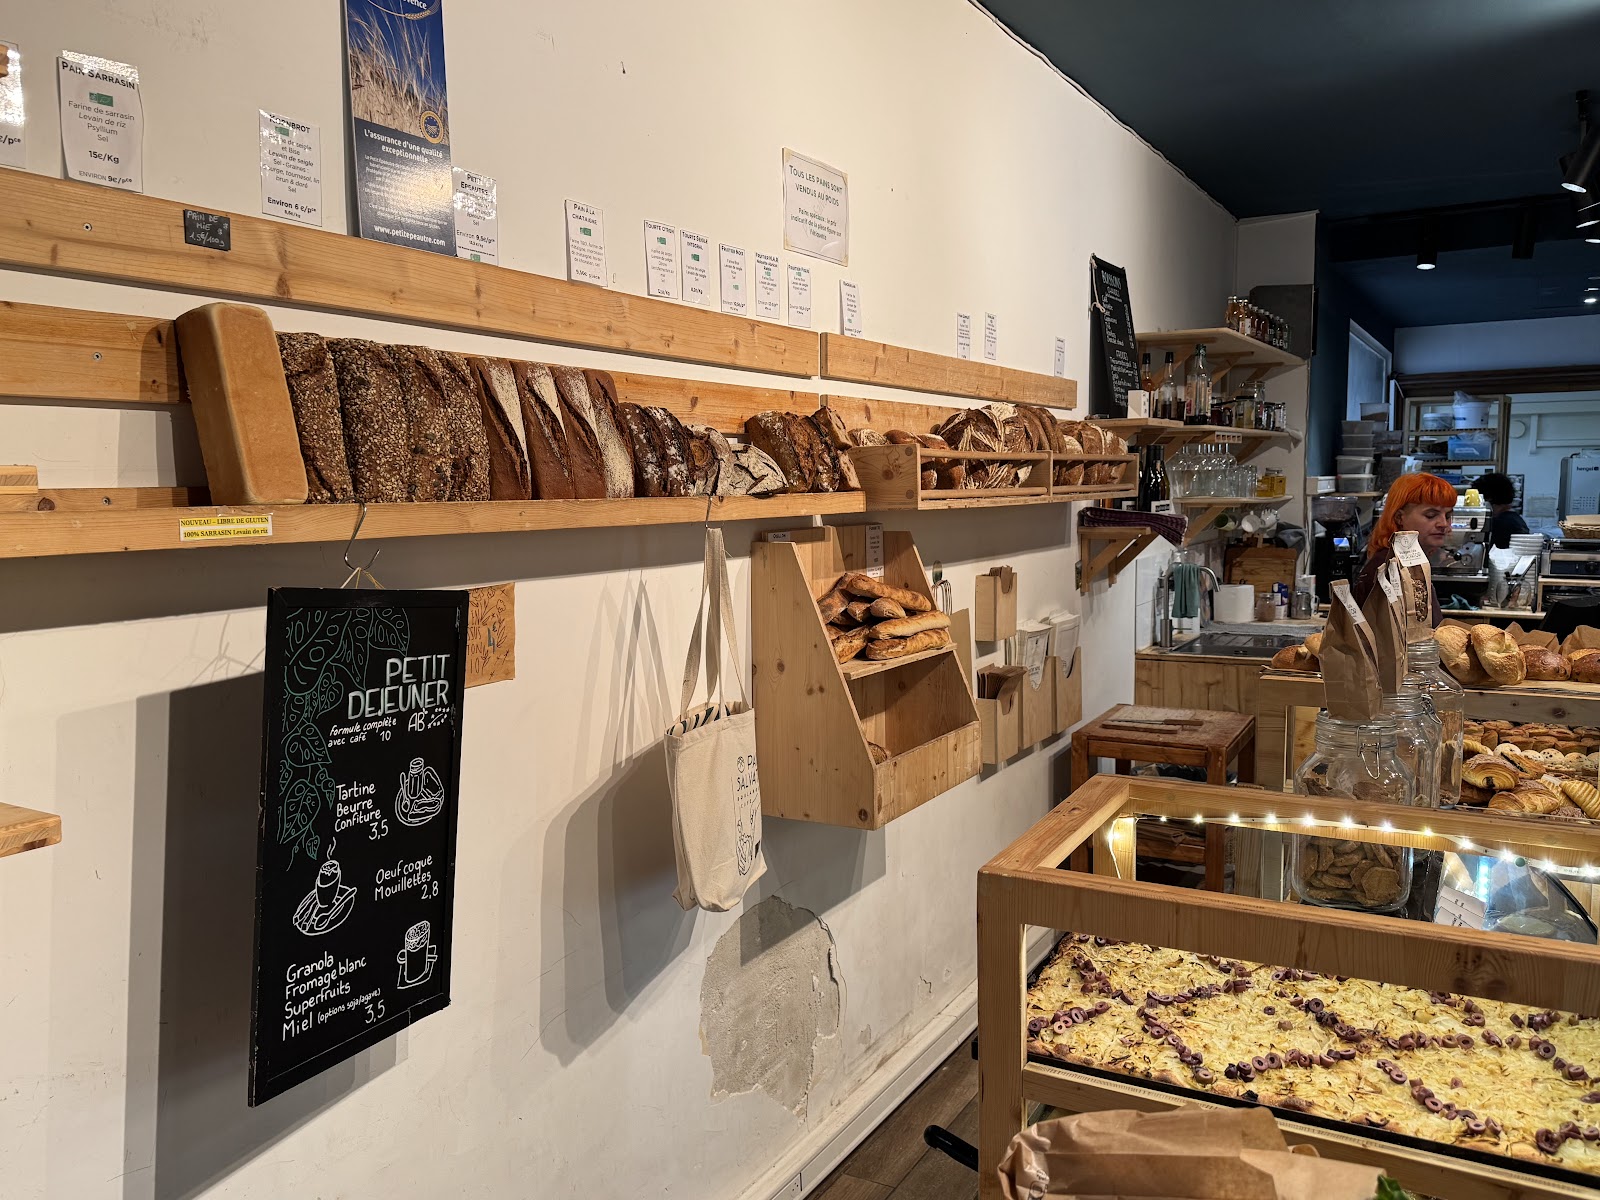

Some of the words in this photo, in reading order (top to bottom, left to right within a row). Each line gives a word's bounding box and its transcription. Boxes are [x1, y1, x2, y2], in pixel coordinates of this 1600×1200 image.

[88, 70, 135, 90] SARRASIN
[68, 101, 92, 112] Farine
[94, 107, 104, 115] de
[105, 110, 135, 121] sarrasin
[79, 112, 103, 124] Levain
[105, 117, 114, 126] de
[116, 120, 126, 128] riz
[87, 123, 118, 136] Psyllium
[97, 134, 109, 142] Sel
[364, 129, 402, 148] L'assurance
[402, 139, 420, 153] d'une
[421, 144, 443, 159] qualité
[381, 144, 428, 164] exceptionnelle
[89, 150, 119, 164] 15€/Kg
[268, 150, 287, 161] Levain
[288, 154, 298, 162] de
[299, 157, 314, 167] seigle
[79, 171, 107, 181] ENVIRON
[789, 165, 804, 179] TOUS
[806, 174, 815, 183] LES
[816, 177, 830, 189] PAINS
[831, 183, 842, 194] SONT
[267, 197, 292, 209] Environ
[795, 183, 817, 197] VENDUS
[818, 191, 825, 200] AU
[826, 195, 839, 206] POIDS
[209, 215, 219, 223] DE
[374, 224, 446, 247] www.petitepeautre.com
[201, 529, 232, 537] SARRASIN
[386, 654, 450, 686] PETIT
[348, 680, 449, 720] DEJEUNER
[330, 722, 361, 736] formule
[363, 717, 396, 733] complète
[328, 737, 345, 747] avec
[350, 732, 367, 744] café
[380, 730, 391, 741] 10
[336, 781, 376, 800] Tartine
[337, 799, 373, 817] Beurre
[335, 809, 381, 832] Confiture
[369, 819, 389, 840] 3,5
[376, 860, 403, 884] Oeuf
[403, 855, 433, 875] coque
[375, 871, 431, 901] Mouillettes
[421, 881, 438, 899] 2,8
[287, 951, 333, 982] Granola
[286, 969, 337, 1000] Fromage
[339, 957, 367, 975] blanc
[285, 980, 350, 1019] Superfruits
[365, 999, 385, 1024] 3,5
[283, 1011, 312, 1041] Miel
[318, 1004, 345, 1024] (options
